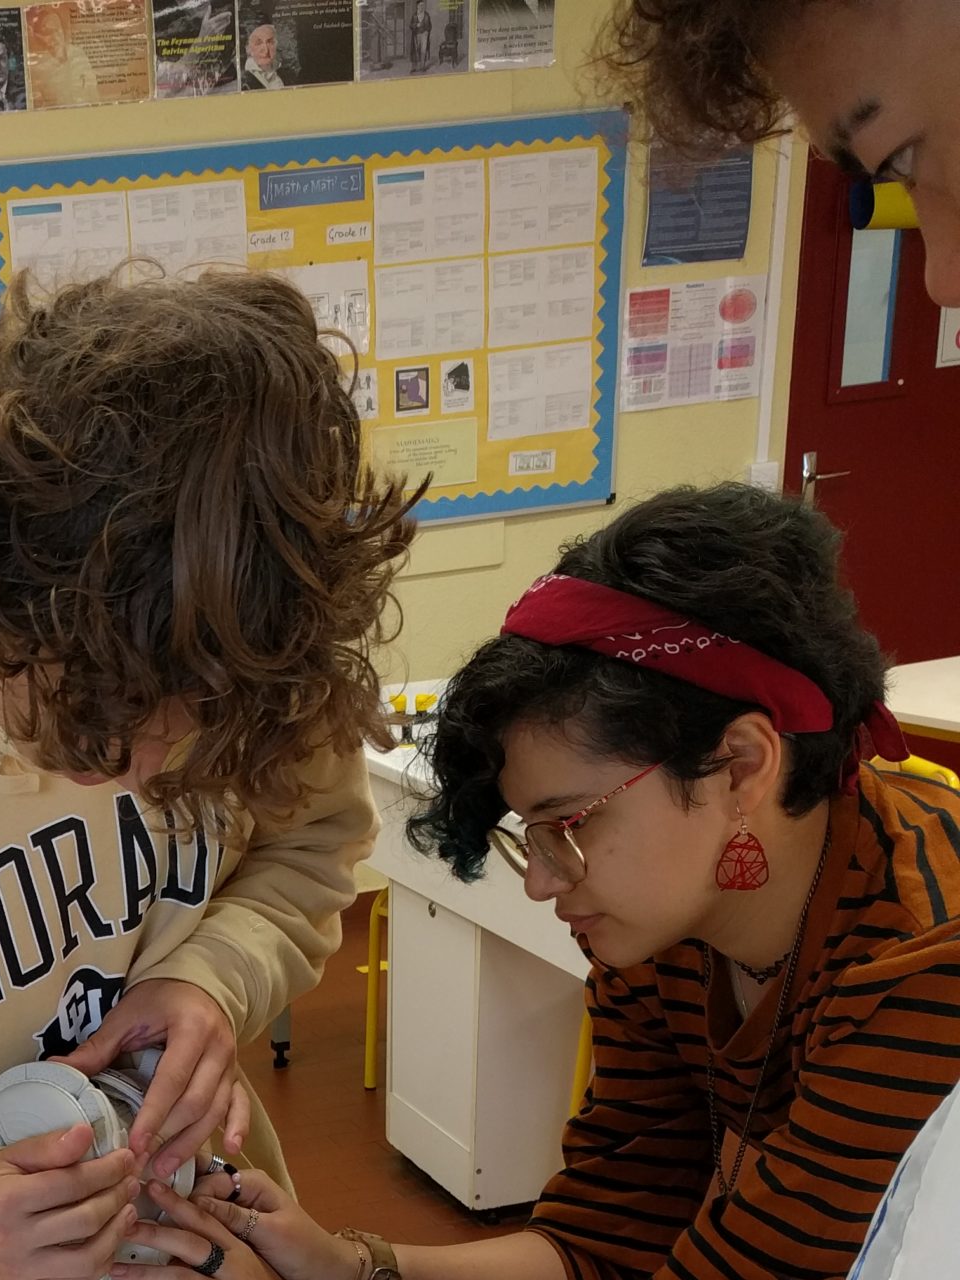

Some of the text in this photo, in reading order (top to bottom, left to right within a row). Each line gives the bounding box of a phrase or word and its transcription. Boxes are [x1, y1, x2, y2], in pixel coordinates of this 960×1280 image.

[250, 231, 290, 246] Grade 12
[328, 226, 368, 241] Grade 11
